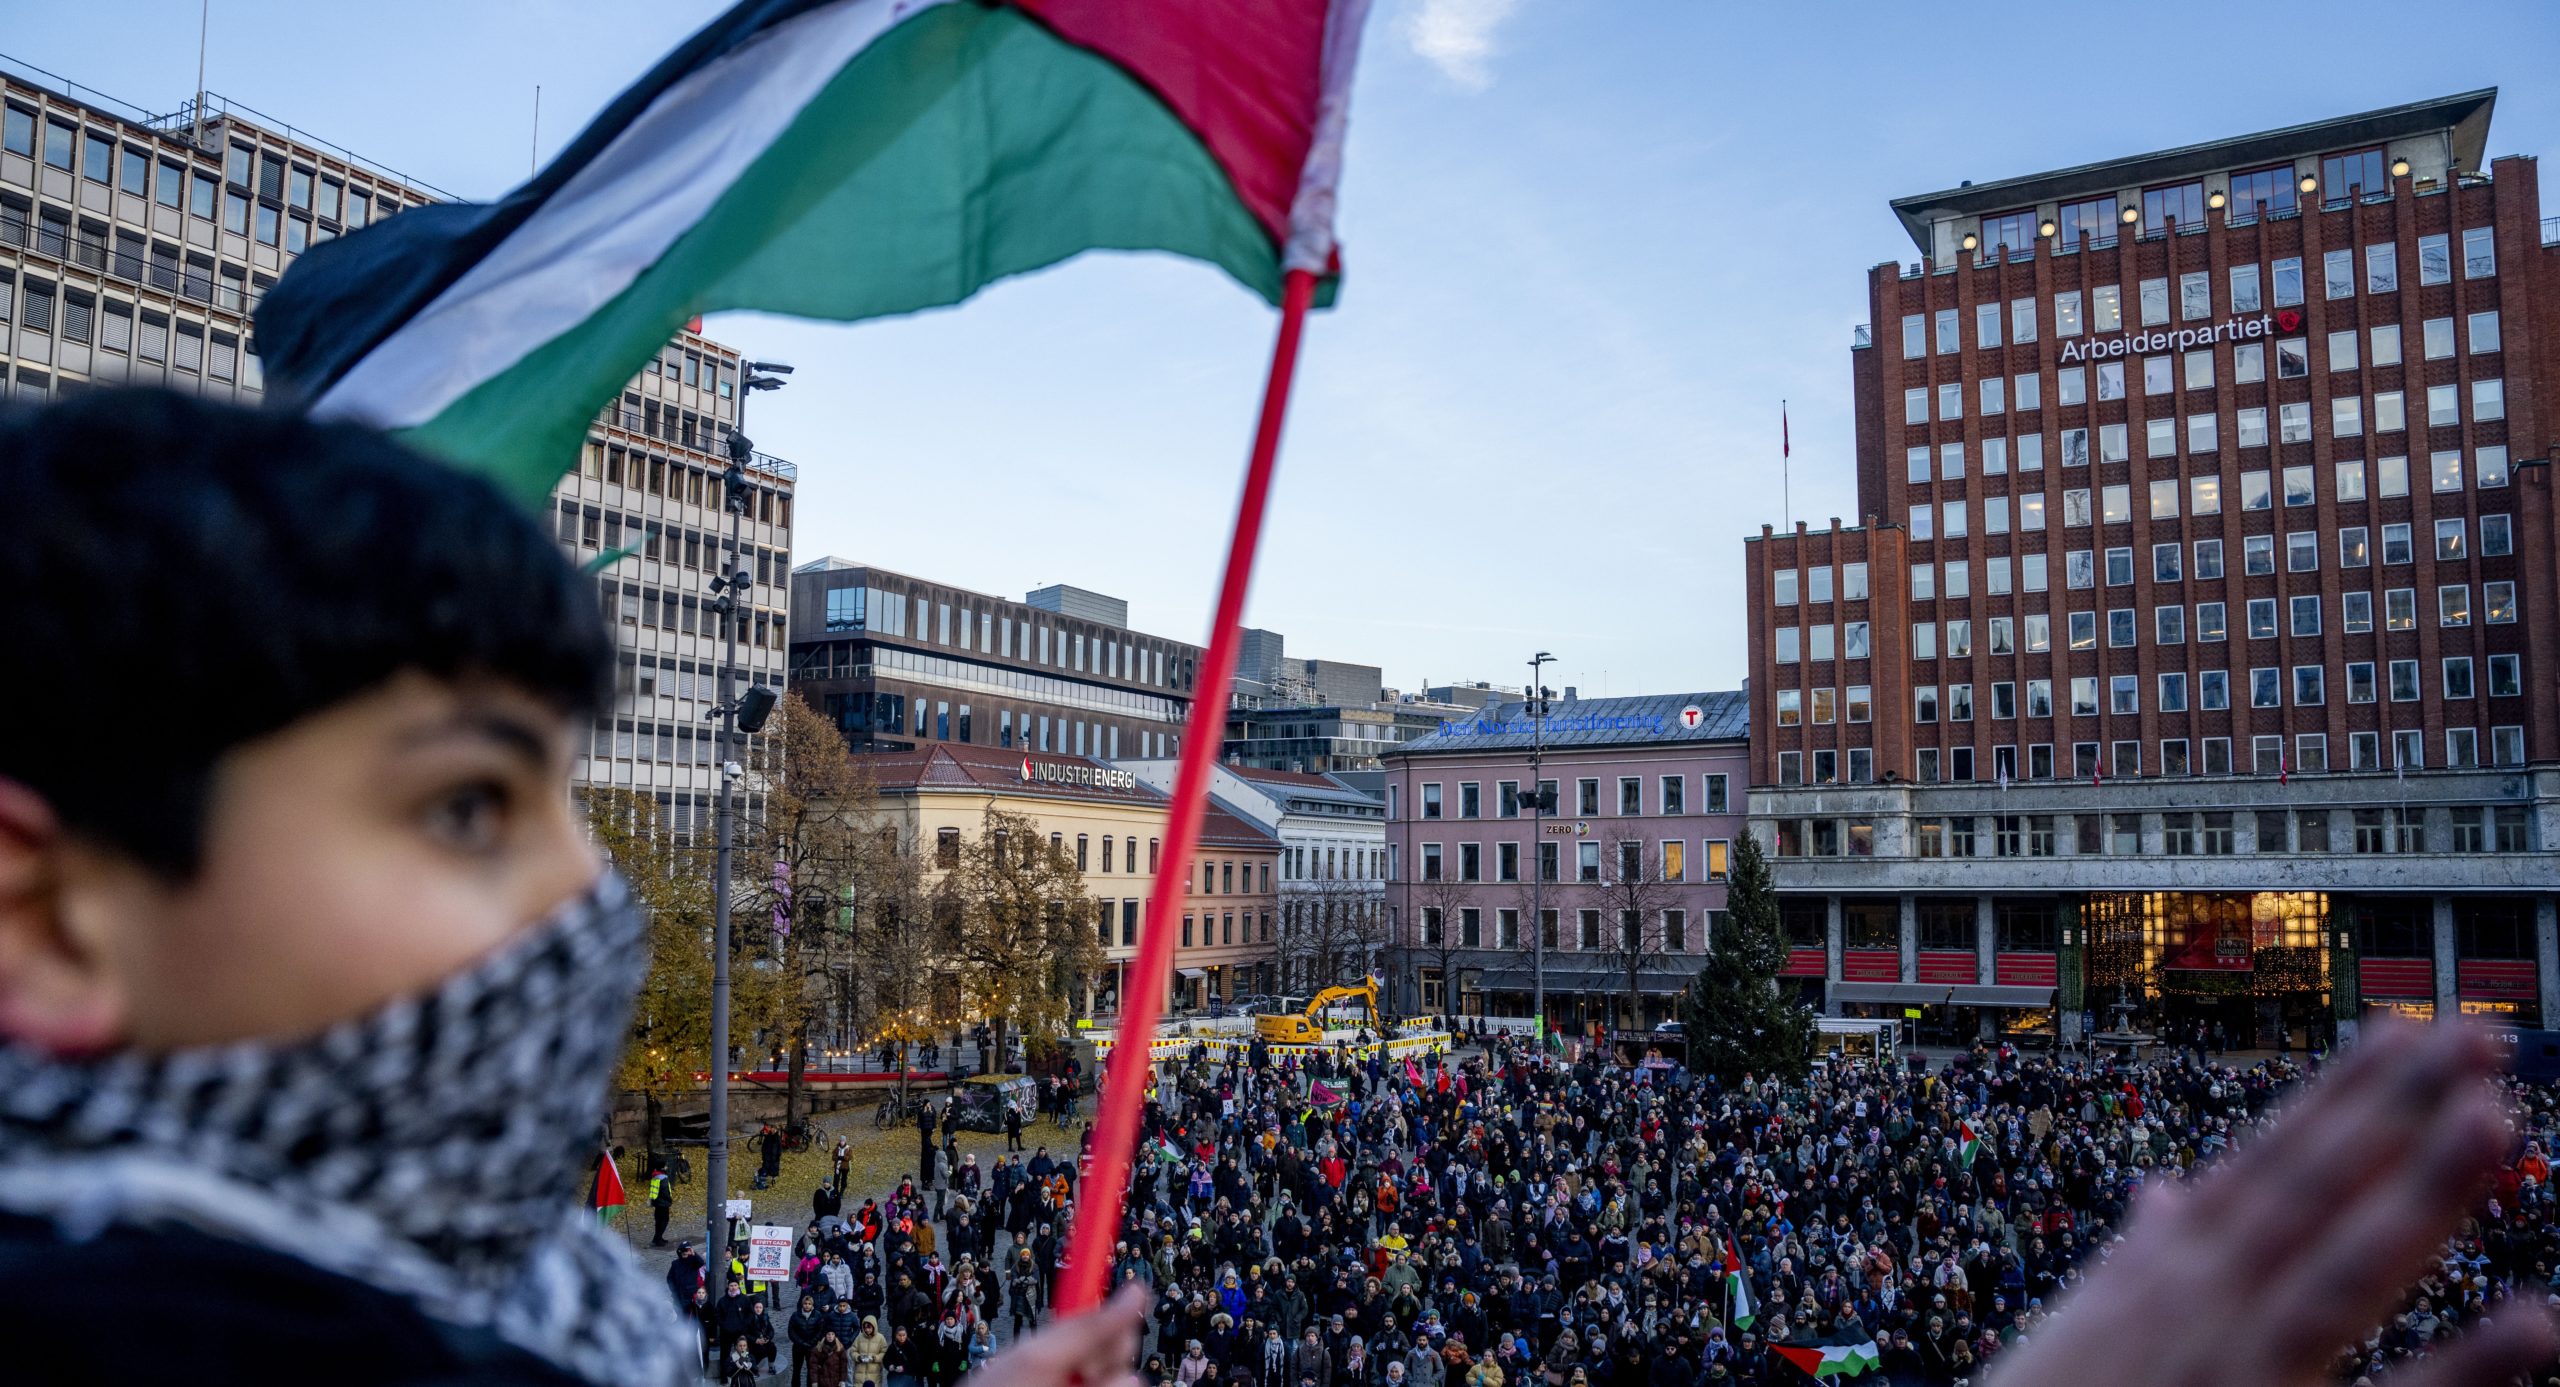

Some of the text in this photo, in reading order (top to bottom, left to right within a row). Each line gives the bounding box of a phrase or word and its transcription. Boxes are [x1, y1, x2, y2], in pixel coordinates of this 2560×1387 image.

[2060, 313, 2273, 363] Arbeiderpartiet
[1439, 712, 1664, 737] Den Norske Turistforening
[1685, 711, 1698, 726] T
[1034, 761, 1136, 789] INDUSTRIENERGI
[1546, 825, 1572, 834] ZERO
[2217, 947, 2245, 956] Saigon
